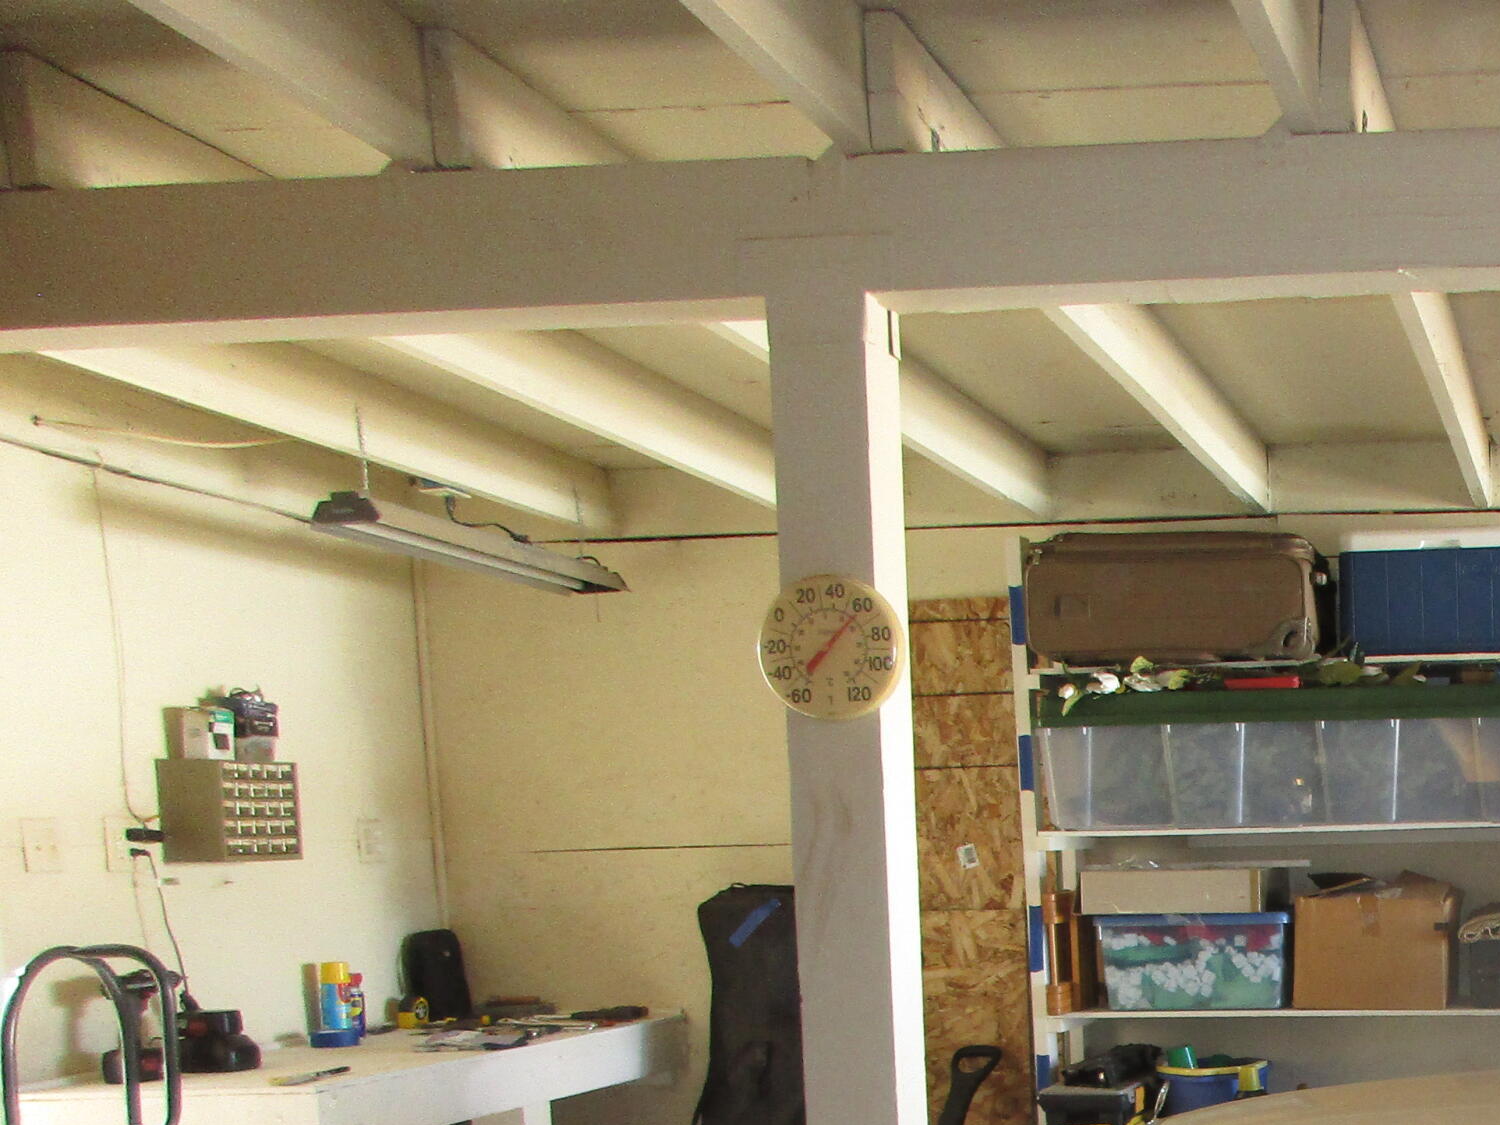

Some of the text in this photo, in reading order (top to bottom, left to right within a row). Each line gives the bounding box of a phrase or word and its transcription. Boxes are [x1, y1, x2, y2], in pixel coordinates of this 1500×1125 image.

[796, 588, 816, 603] 20
[825, 584, 845, 598] 40
[852, 598, 873, 612] 60
[774, 607, 785, 622] 0
[871, 626, 891, 641] 80
[868, 656, 894, 671] 100
[847, 686, 872, 701] 120
